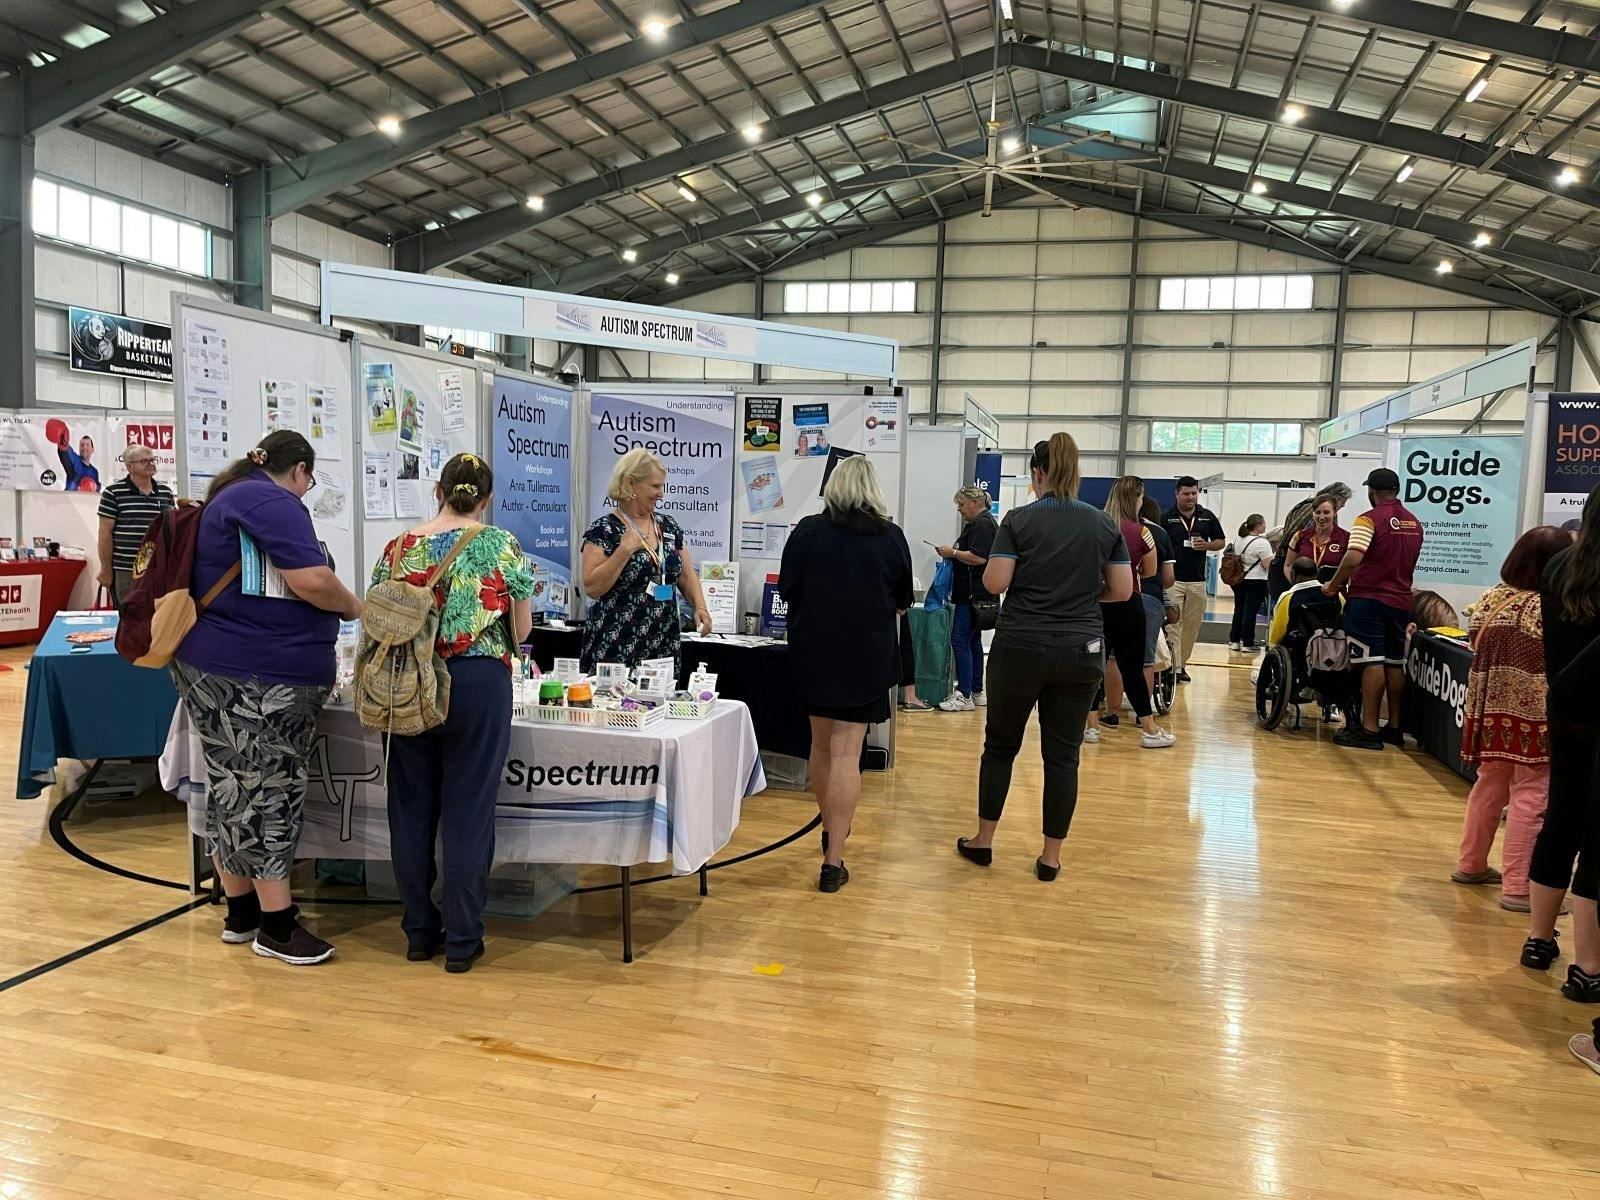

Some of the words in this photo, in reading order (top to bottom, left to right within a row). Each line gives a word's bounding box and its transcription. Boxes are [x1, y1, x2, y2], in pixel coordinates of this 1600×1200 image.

[600, 315, 638, 336] AUTISM
[641, 321, 693, 342] SPECTRUM
[126, 351, 171, 367] BASKETBALL
[536, 392, 569, 410] Understanding
[666, 401, 723, 412] Understanding
[498, 394, 545, 425] Autism
[598, 410, 675, 433] Autism
[507, 428, 569, 461] Spectrum
[1406, 449, 1501, 477] Guide
[525, 464, 553, 478] Workshops
[667, 466, 695, 476] kshops
[509, 478, 526, 492] Anna
[527, 479, 561, 494] Tullemans
[663, 483, 710, 495] llemans
[1404, 478, 1491, 515] Dogs.
[1569, 498, 1587, 506] trul
[501, 499, 524, 512] Author
[531, 499, 567, 513] Consultant
[654, 499, 719, 512] Consultant
[540, 525, 555, 534] Books
[1461, 521, 1469, 529] in
[1470, 522, 1489, 530] their
[684, 529, 698, 537] oks
[700, 529, 714, 537] and
[1425, 529, 1471, 538] environment
[535, 538, 550, 548] Guide
[690, 538, 723, 548] Manuals
[1415, 564, 1470, 574] dogsqld.com.au
[1407, 647, 1441, 697] Guide
[505, 758, 660, 792] Spectrum
